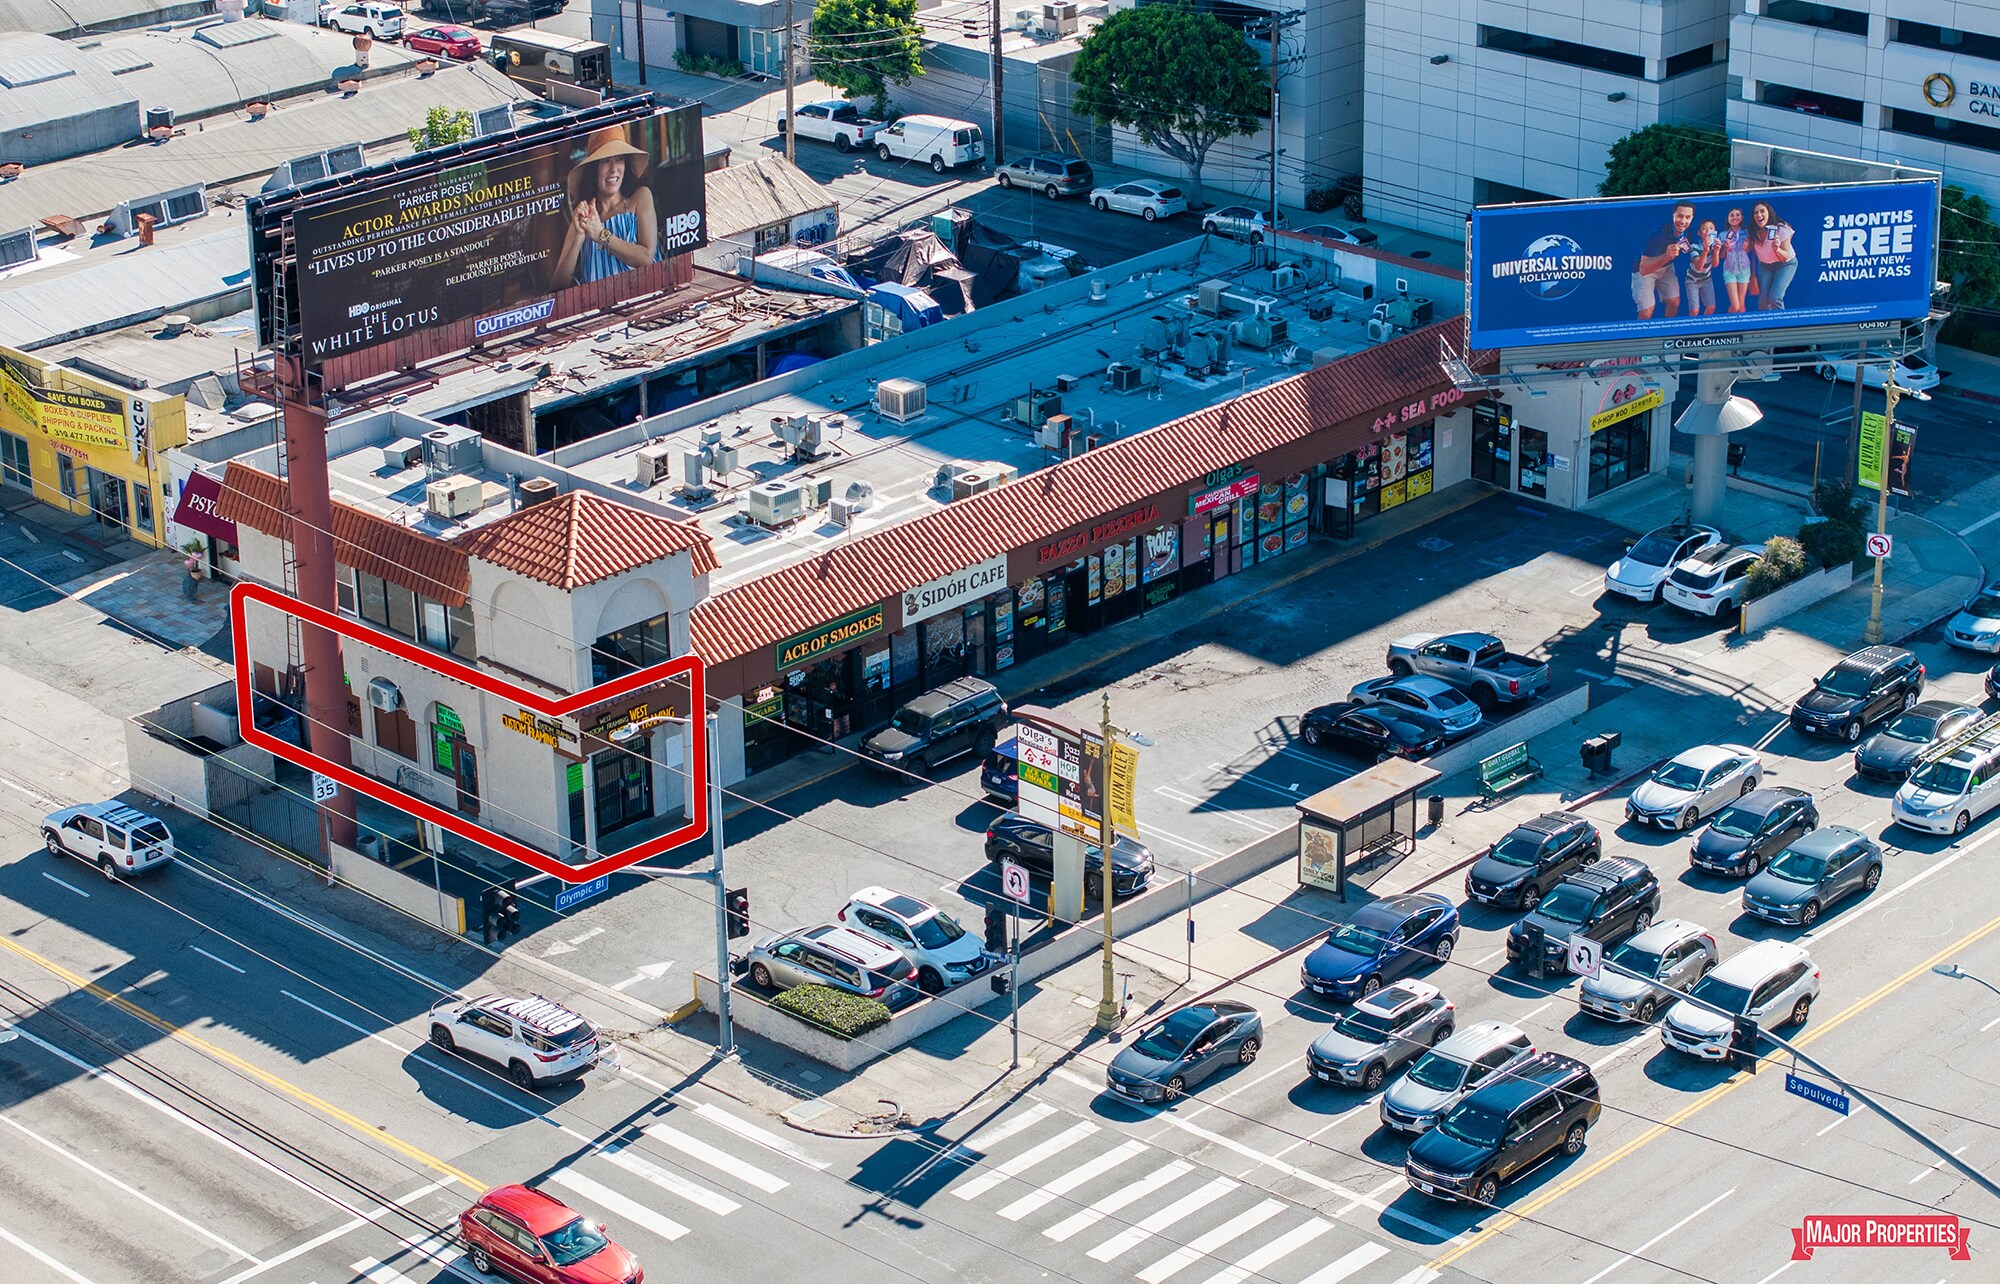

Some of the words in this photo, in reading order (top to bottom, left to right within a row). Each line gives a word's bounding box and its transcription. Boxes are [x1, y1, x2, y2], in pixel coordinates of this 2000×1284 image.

[1969, 100, 1999, 117] CAL
[409, 187, 426, 195] YOUR
[429, 171, 483, 189] CONSIDERATION
[399, 190, 439, 210] PARKER
[441, 181, 474, 198] POSEY
[342, 214, 395, 240] ACTOR
[398, 196, 461, 224] AWARDS
[464, 176, 533, 206] NOMINEE
[312, 236, 365, 256] OUTSTANDING
[367, 220, 420, 241] PERFORMANCE
[421, 216, 431, 226] BY
[440, 207, 467, 221] FEMALE
[469, 202, 493, 213] ACTOR
[495, 198, 503, 206] IN
[511, 190, 536, 201] DRAMA
[537, 182, 561, 193] SERIES
[666, 210, 700, 236] HBO
[1823, 215, 1835, 229] 3
[1838, 209, 1914, 228] MONTHS
[356, 246, 376, 263] UP
[377, 240, 397, 258] TO
[398, 233, 426, 252] THE
[427, 205, 525, 243] CONSIDERABLE
[667, 229, 700, 250] max
[408, 256, 433, 269] POSEY
[434, 253, 442, 262] IS
[443, 250, 449, 259] A
[1492, 256, 1558, 279] UNIVERSAL
[1561, 255, 1613, 271] STUDIOS
[1827, 259, 1855, 269] WITH
[1856, 257, 1879, 267] ANY
[1880, 255, 1905, 265] NEW
[445, 266, 492, 286] DELICIOUSLY
[1519, 271, 1586, 284] HOLLYWOOD
[1817, 268, 1876, 283] ANNUAL
[1878, 265, 1911, 278] PASS
[348, 302, 370, 318] HBO
[370, 297, 403, 311] ORIGINAL
[478, 302, 551, 333] OUTFRONT
[362, 311, 388, 327] THE
[312, 326, 374, 355] WHITE
[382, 306, 439, 335] LOTUS
[47, 392, 66, 403] SAVE
[67, 396, 79, 405] ON
[80, 399, 106, 409] BOXES
[1401, 400, 1426, 422] SEA
[1430, 388, 1465, 410] FOOD
[43, 405, 68, 417] BOXES
[70, 409, 76, 417] &
[76, 411, 112, 424] SUPPLIES
[1602, 413, 1615, 424] HOP
[42, 416, 75, 429] SHIPPING
[77, 421, 83, 430] &
[84, 423, 117, 435] PACKING
[1863, 415, 1878, 443] AILEY
[104, 437, 123, 447] FedEx
[1861, 442, 1874, 470] ALVIN
[1206, 463, 1242, 487] Olga's
[1195, 490, 1231, 508] MEXICAN
[1218, 492, 1241, 505] GRILL
[1039, 532, 1089, 563] PAZZO
[1092, 504, 1160, 544] PIZZERIA
[1146, 530, 1173, 558] MOLE
[921, 578, 967, 608] SIDÓH
[970, 564, 1005, 590] CAFE
[783, 641, 809, 664] ACE
[810, 634, 829, 652] OF
[829, 612, 883, 644] SMOKES
[519, 710, 535, 727] WEST
[629, 704, 648, 721] WEST
[501, 714, 528, 736] CUSTOM
[528, 726, 558, 749] FRAMING
[1022, 726, 1053, 746] Olga's
[1060, 761, 1077, 773] HOP
[1113, 746, 1129, 781] AILEY
[317, 783, 334, 798] 35
[1111, 780, 1126, 813] ALVIN
[560, 885, 593, 905] Olympic
[1790, 1079, 1845, 1110] Sepulveda
